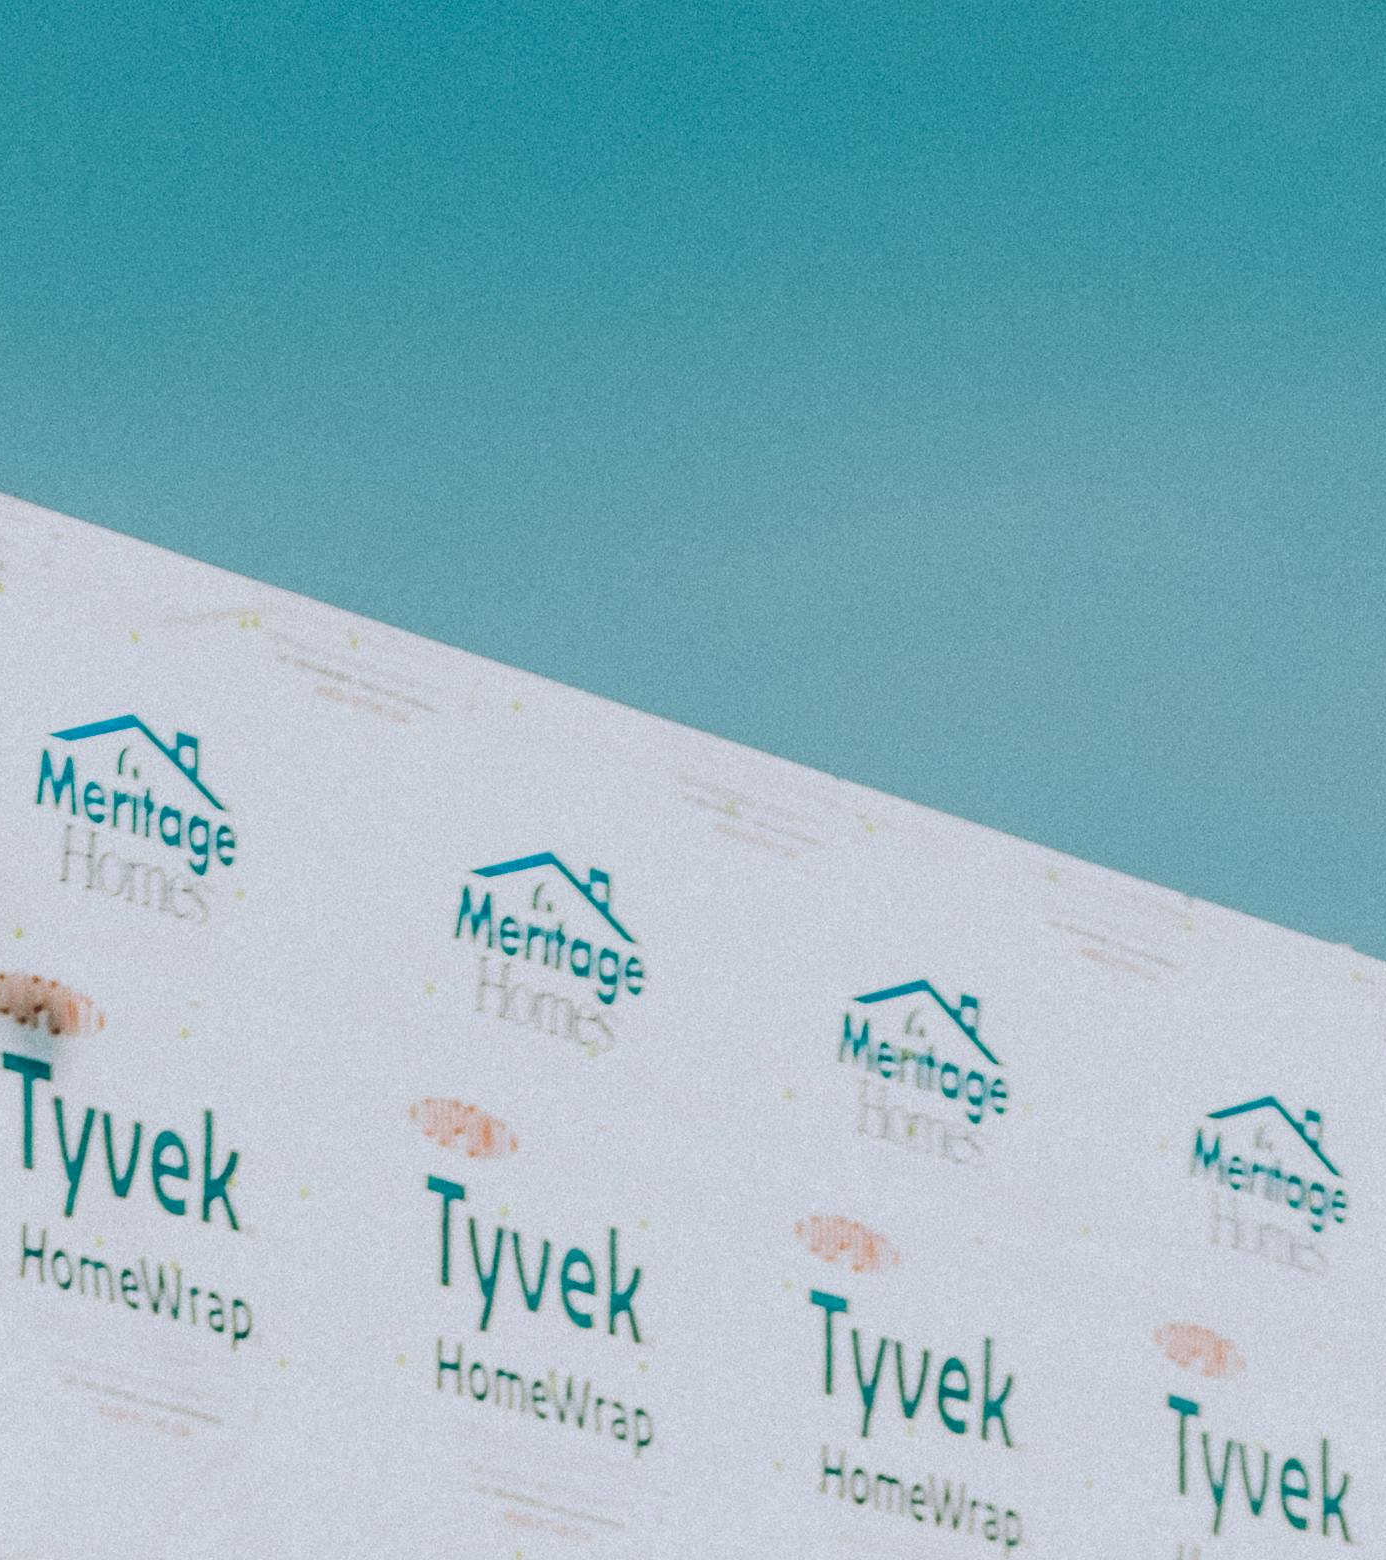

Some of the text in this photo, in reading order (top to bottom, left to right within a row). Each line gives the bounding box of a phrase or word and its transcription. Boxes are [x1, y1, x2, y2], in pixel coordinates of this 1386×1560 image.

[36, 746, 238, 875] Meritage
[455, 884, 646, 1005] Meritage
[3, 1051, 241, 1232] Tyvek
[21, 1223, 253, 1345] HomeWrap
[427, 1174, 643, 1344] Tyvek
[436, 1337, 654, 1459] HomeWrap
[810, 1289, 1015, 1449] Tyvek
[818, 1445, 1023, 1551] HomeWrap
[1168, 1394, 1354, 1543] Tyvek
